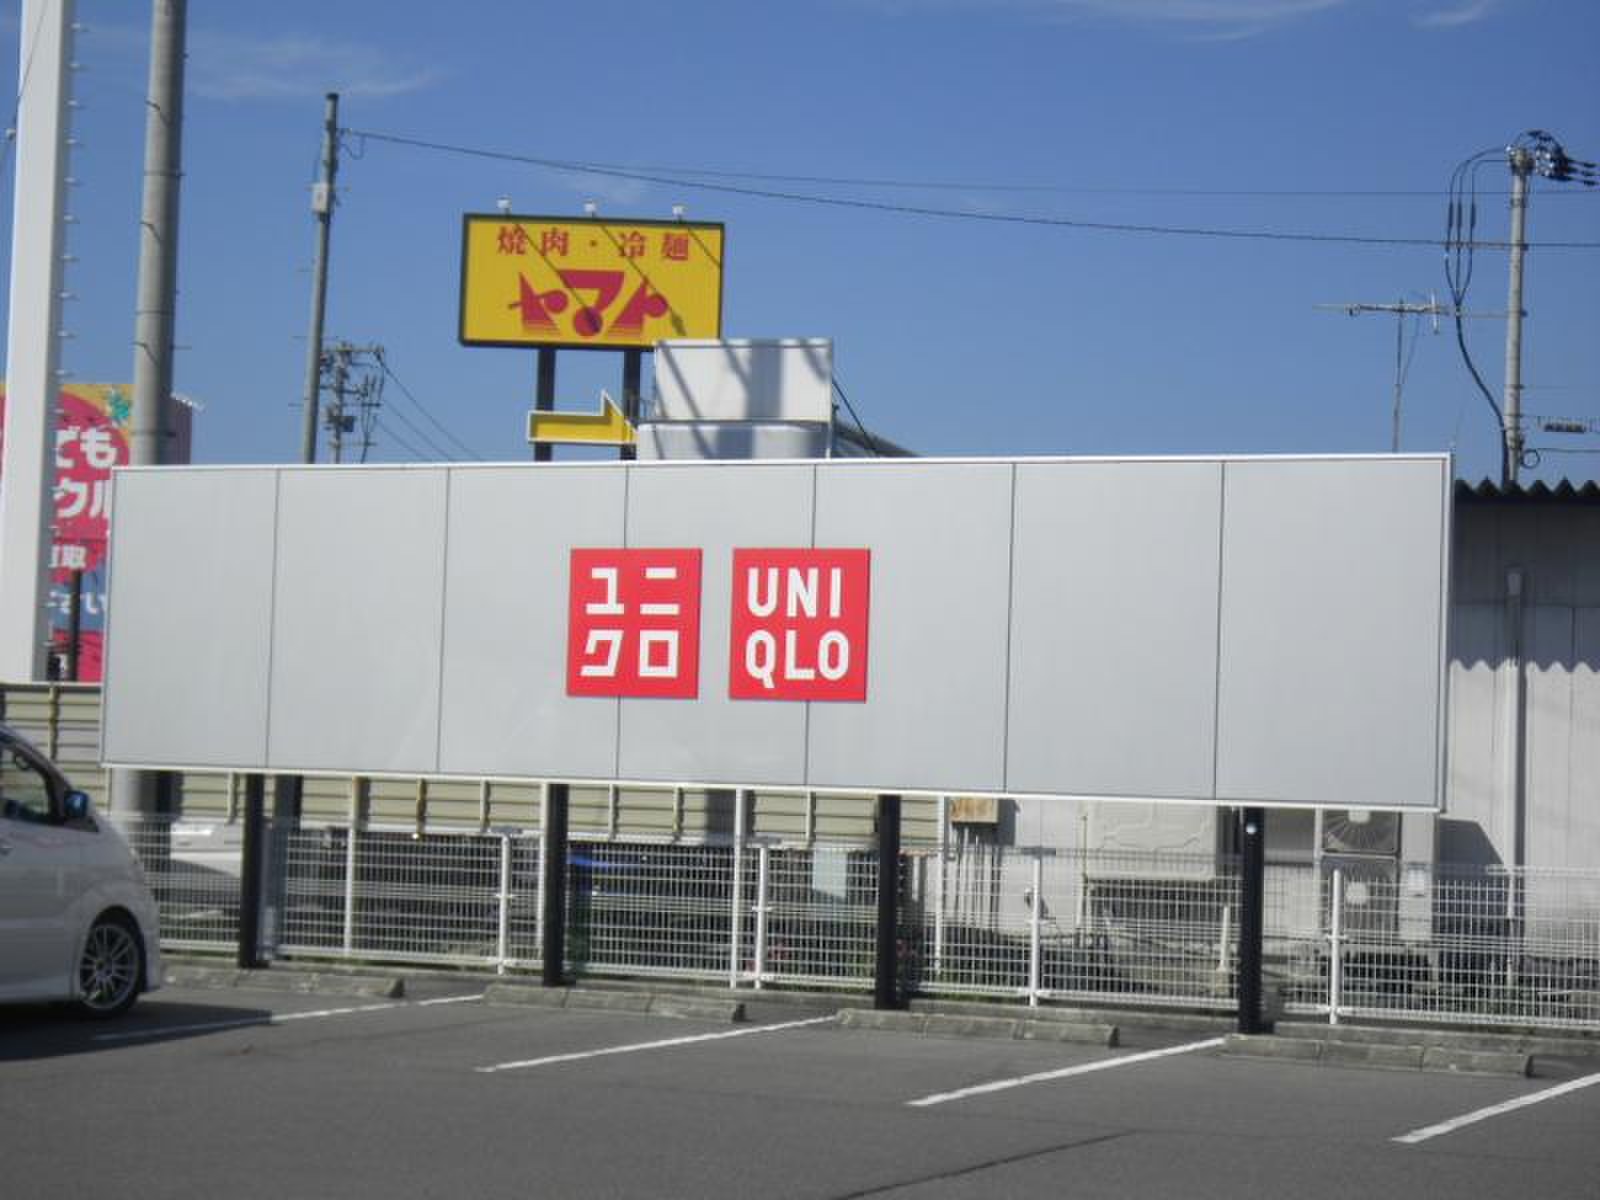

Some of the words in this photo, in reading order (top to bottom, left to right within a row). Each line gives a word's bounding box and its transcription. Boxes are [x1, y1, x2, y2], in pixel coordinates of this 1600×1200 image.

[508, 268, 669, 338] ヤマト
[584, 566, 681, 616] ユニ
[746, 566, 842, 618] UNI
[579, 629, 680, 678] クロ
[744, 629, 850, 689] QLO
